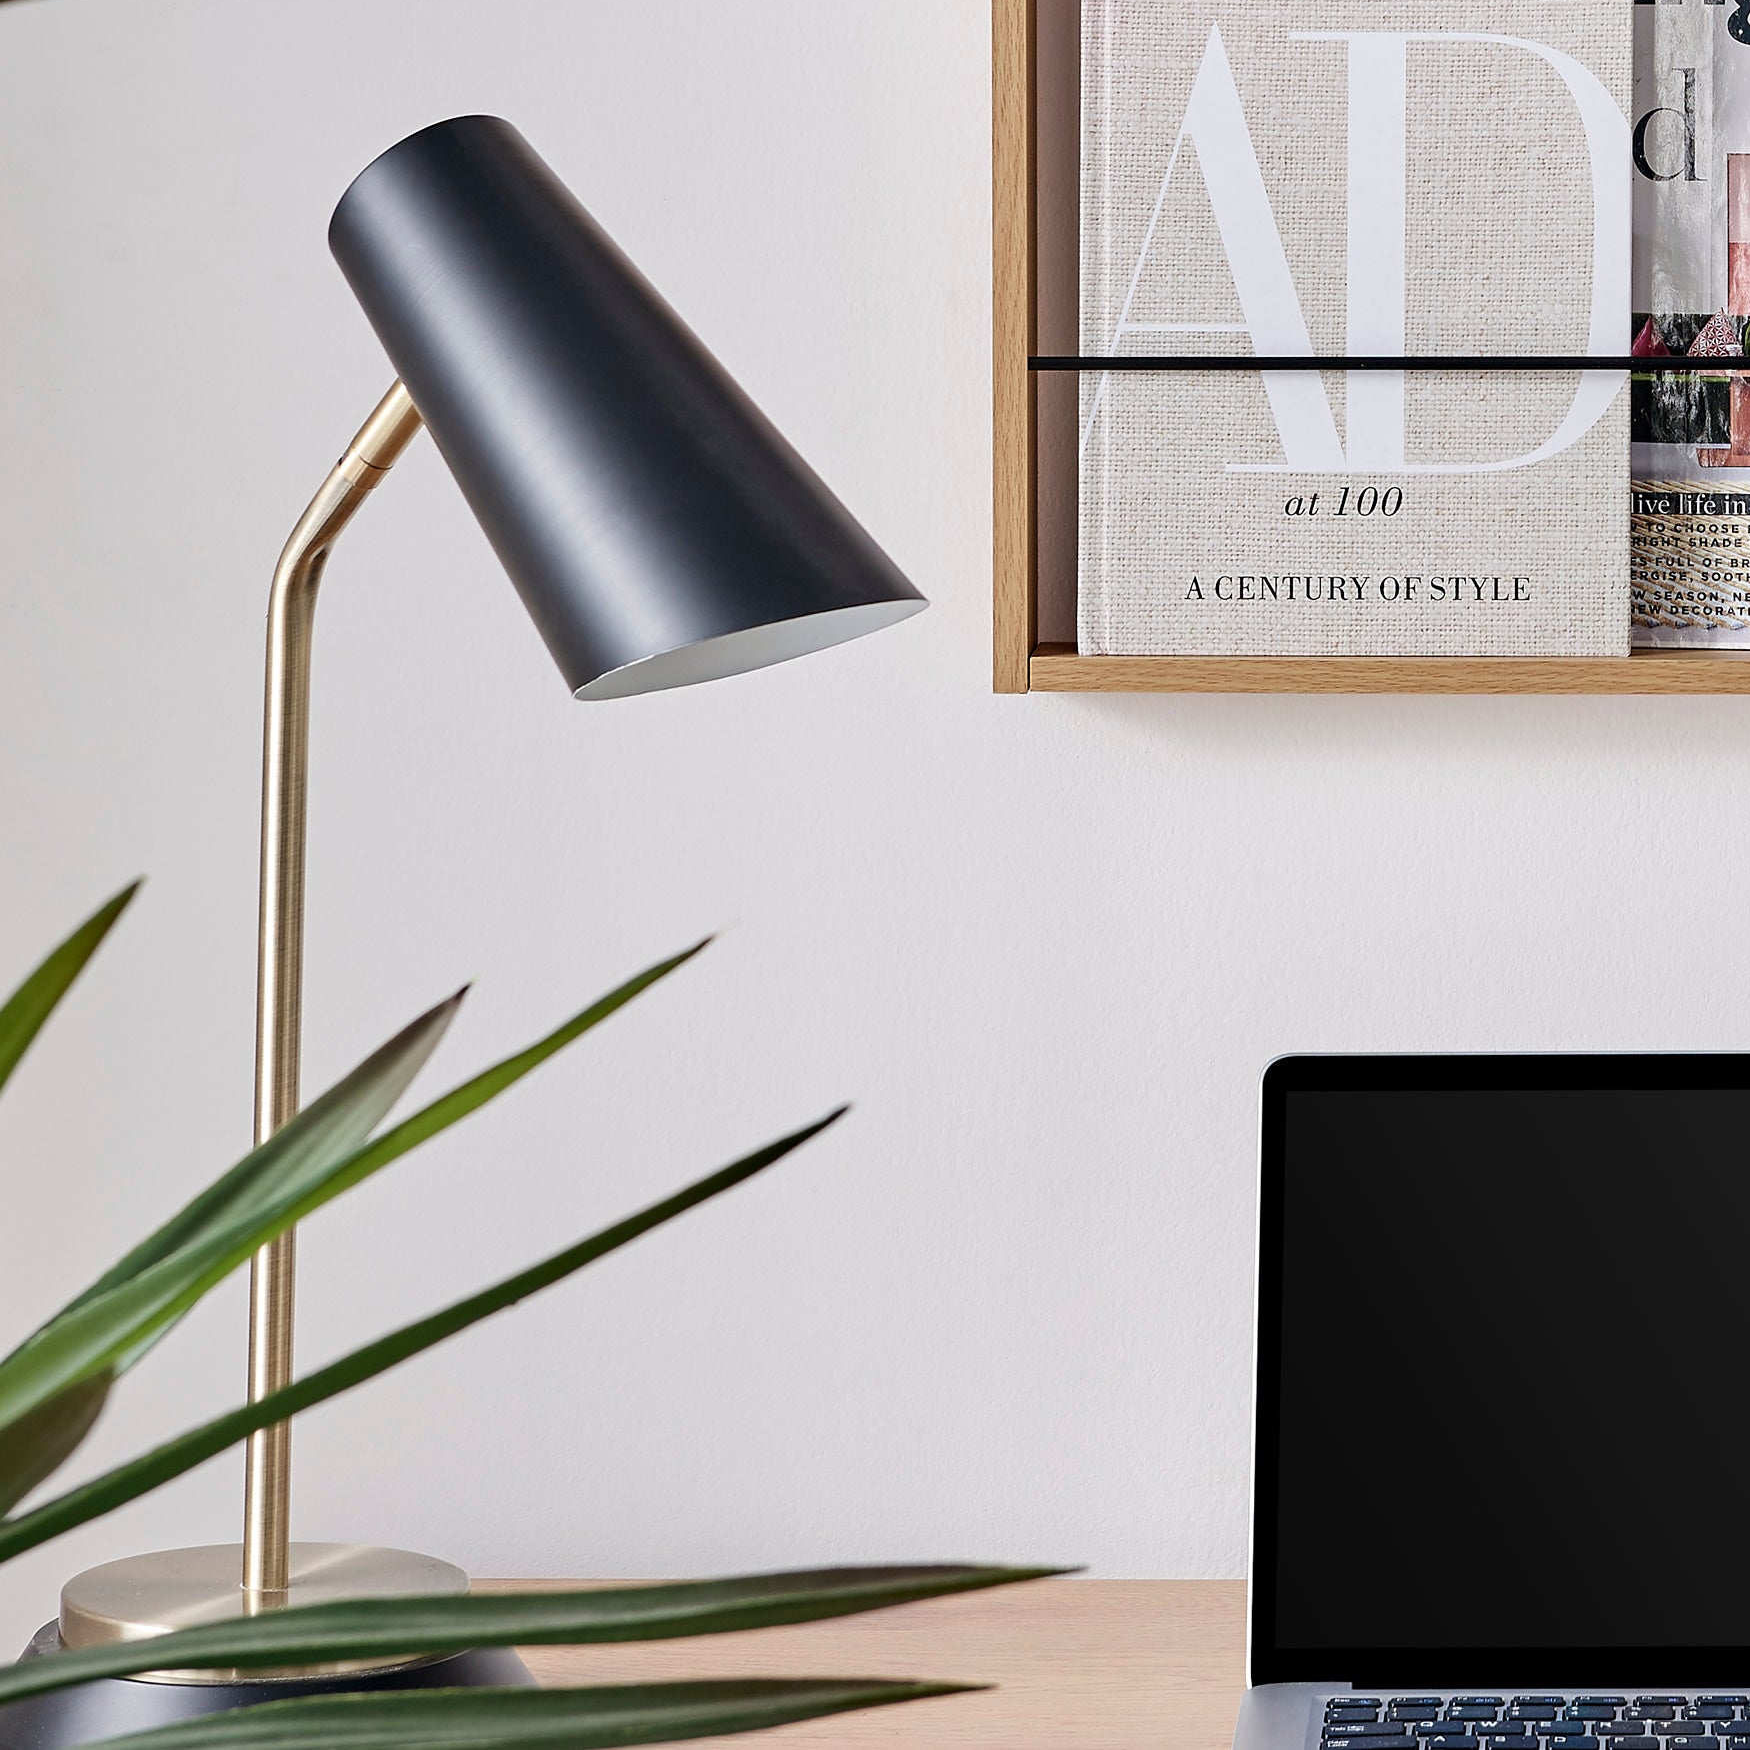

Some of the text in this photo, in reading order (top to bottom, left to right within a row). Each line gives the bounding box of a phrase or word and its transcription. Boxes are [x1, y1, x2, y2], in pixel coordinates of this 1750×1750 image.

[1081, 20, 1632, 474] AD
[1284, 487, 1403, 517] at 100
[1631, 493, 1670, 514] live
[1680, 493, 1717, 515] life
[1724, 495, 1746, 515] in
[1647, 523, 1666, 532] TO
[1674, 523, 1740, 534] CHOOSE
[1632, 537, 1680, 547] RIGHT
[1689, 537, 1742, 548] SHADE
[1656, 557, 1694, 567] FULL
[1702, 558, 1723, 567] OF
[1185, 576, 1531, 601] A CENTURY OF STYLE
[1654, 591, 1725, 603] SEASON,
